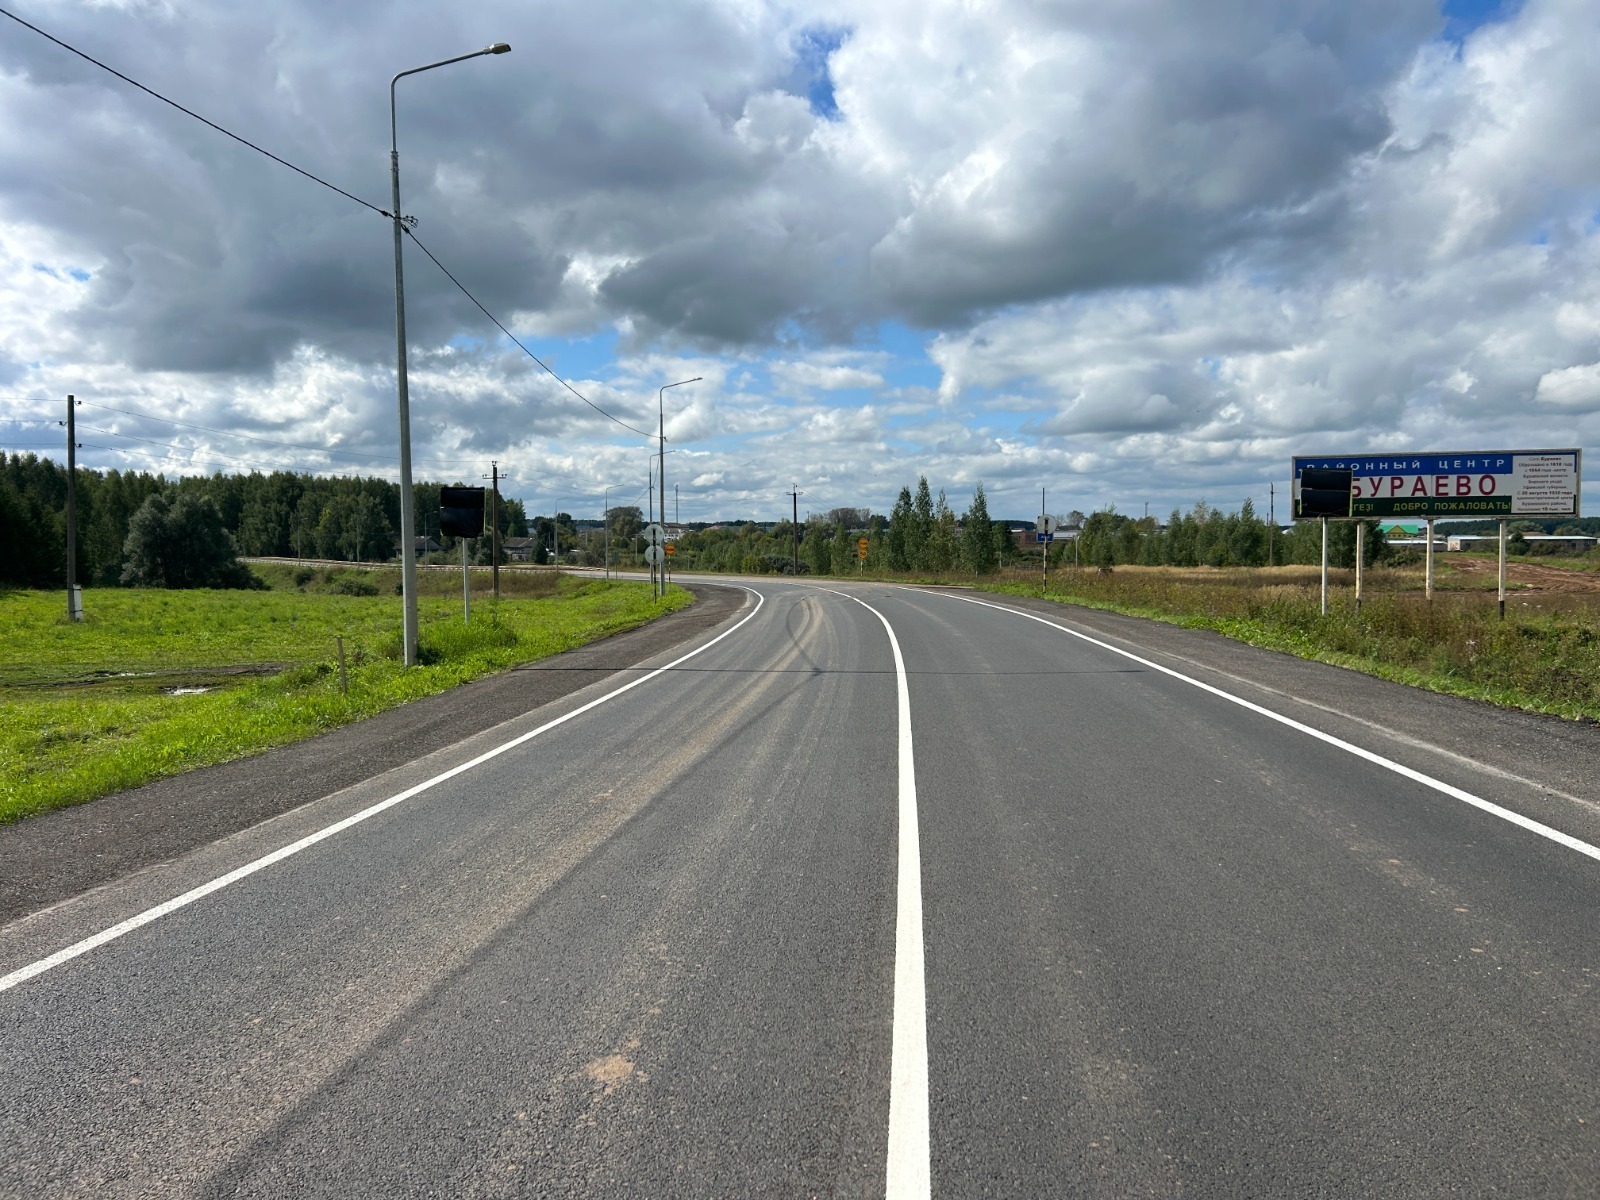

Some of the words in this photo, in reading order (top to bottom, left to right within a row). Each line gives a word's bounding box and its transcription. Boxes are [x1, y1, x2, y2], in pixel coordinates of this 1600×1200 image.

[1439, 459, 1505, 470] ЦЕНТР
[1352, 474, 1496, 497] БУРАЕВО
[1393, 502, 1428, 512] ДОБРО
[1434, 501, 1511, 511] ПОЖАЛОВАТЬ!
